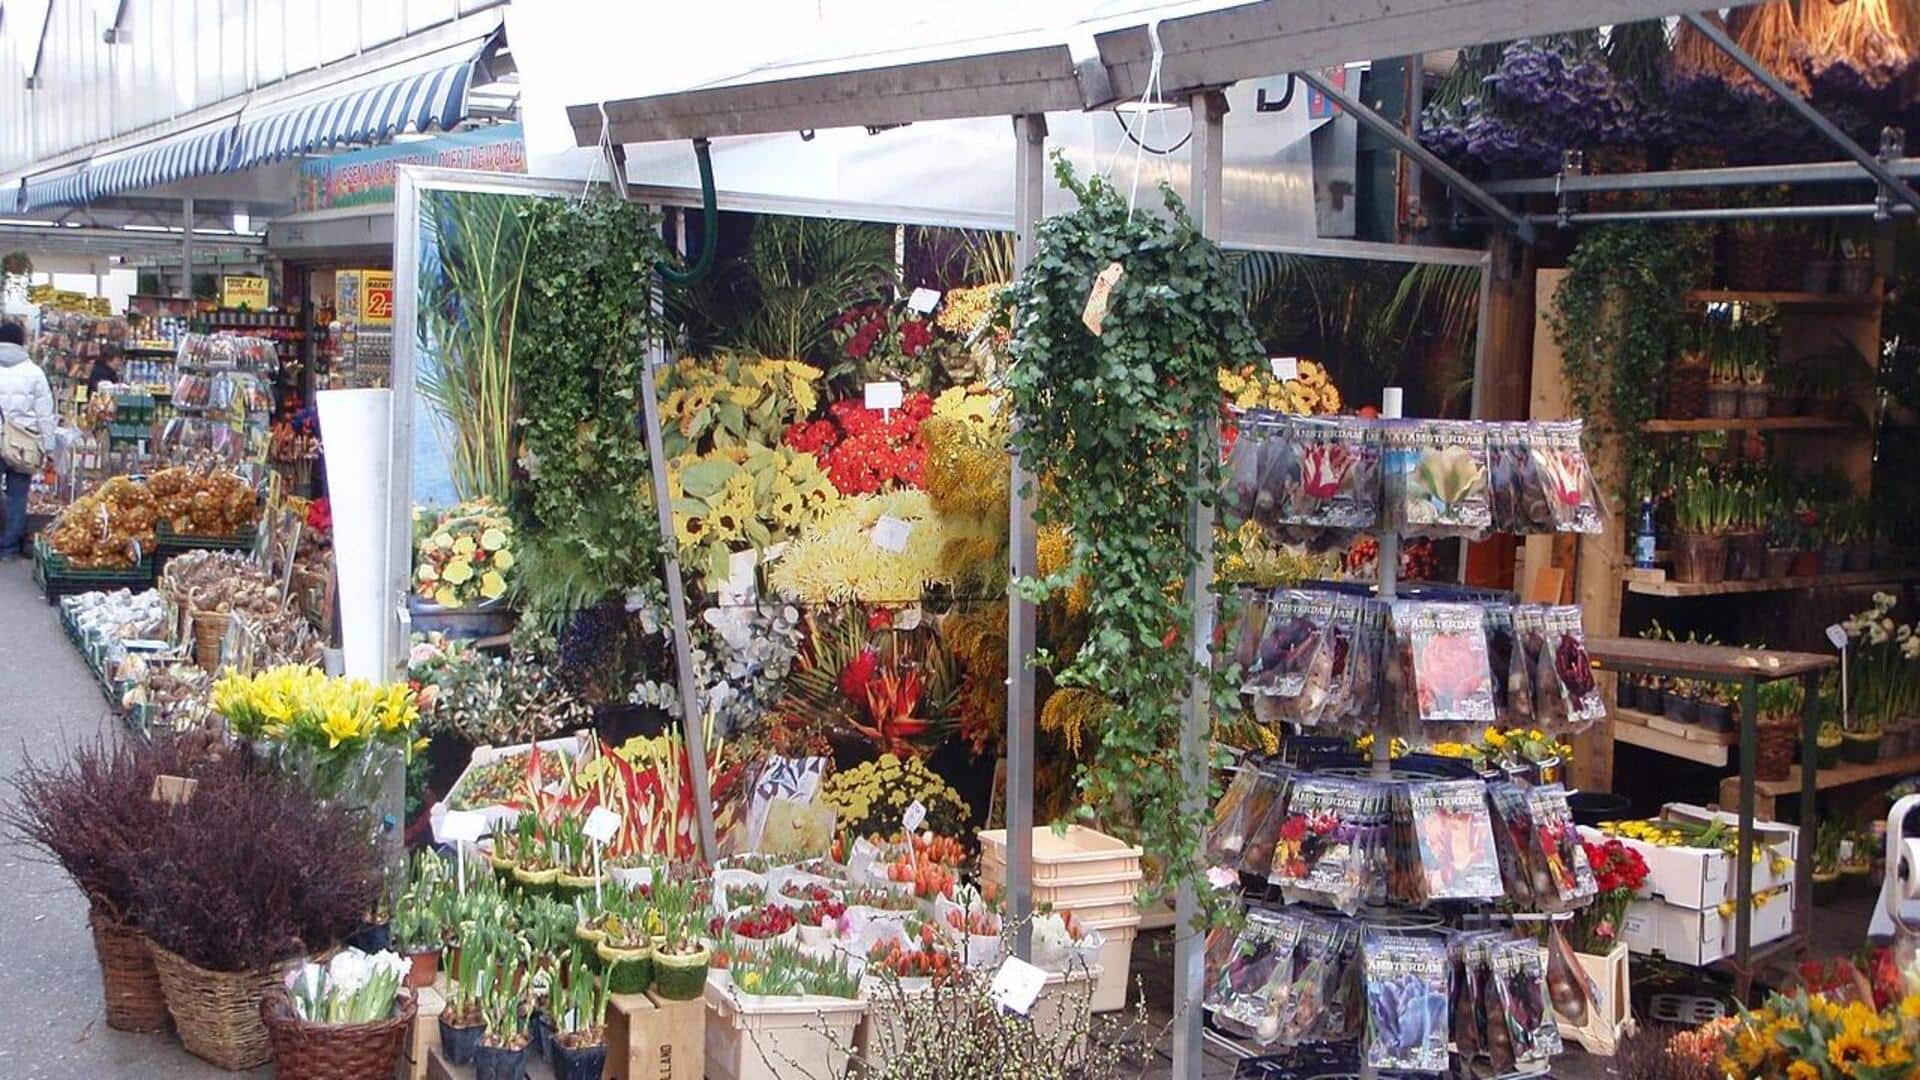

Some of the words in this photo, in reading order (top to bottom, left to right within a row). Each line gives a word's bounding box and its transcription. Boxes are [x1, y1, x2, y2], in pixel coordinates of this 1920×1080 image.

[485, 142, 523, 169] WORLD
[1293, 428, 1363, 441] AMSTERDAM
[1408, 431, 1483, 445] AMSTERDAM
[1271, 600, 1332, 618] AMSTERDAM
[1411, 617, 1480, 631] AMSTERDAM
[1292, 792, 1362, 809] AMSTERDAM
[1413, 796, 1484, 808] AMSTERDAM
[1366, 959, 1444, 974] AMSTERDAM
